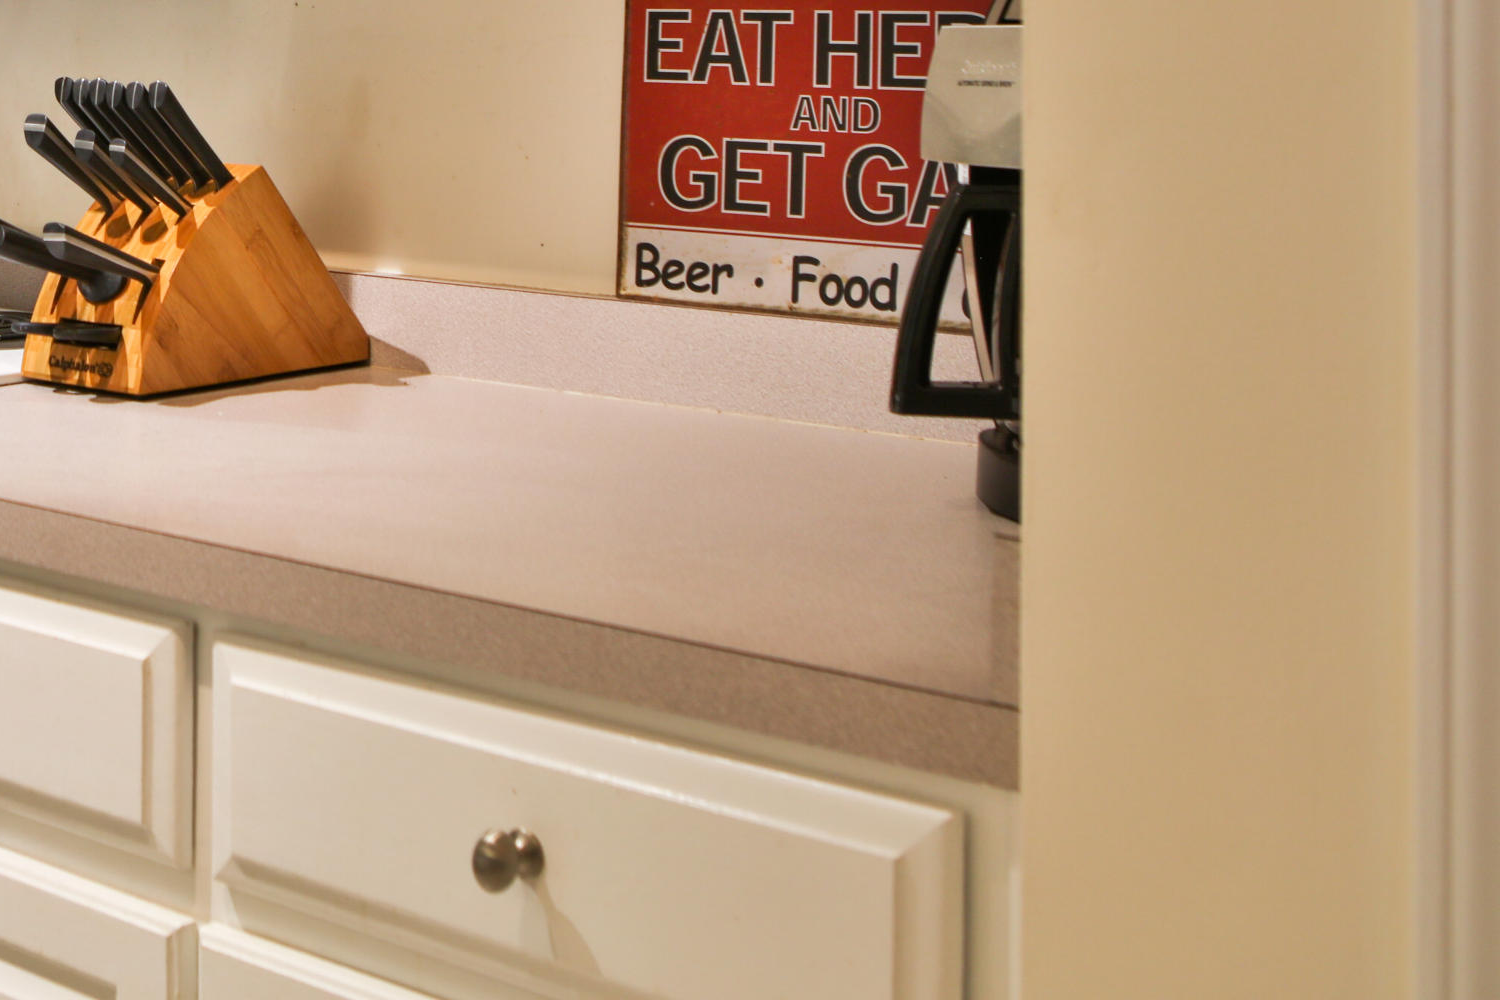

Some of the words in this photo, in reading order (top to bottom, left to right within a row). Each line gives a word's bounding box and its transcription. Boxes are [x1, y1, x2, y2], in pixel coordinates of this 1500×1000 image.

[644, 8, 794, 87] EAT
[812, 10, 988, 91] HE
[790, 94, 881, 134] AND
[657, 134, 825, 219] GET
[635, 242, 734, 295] Beer
[791, 254, 899, 312] Food
